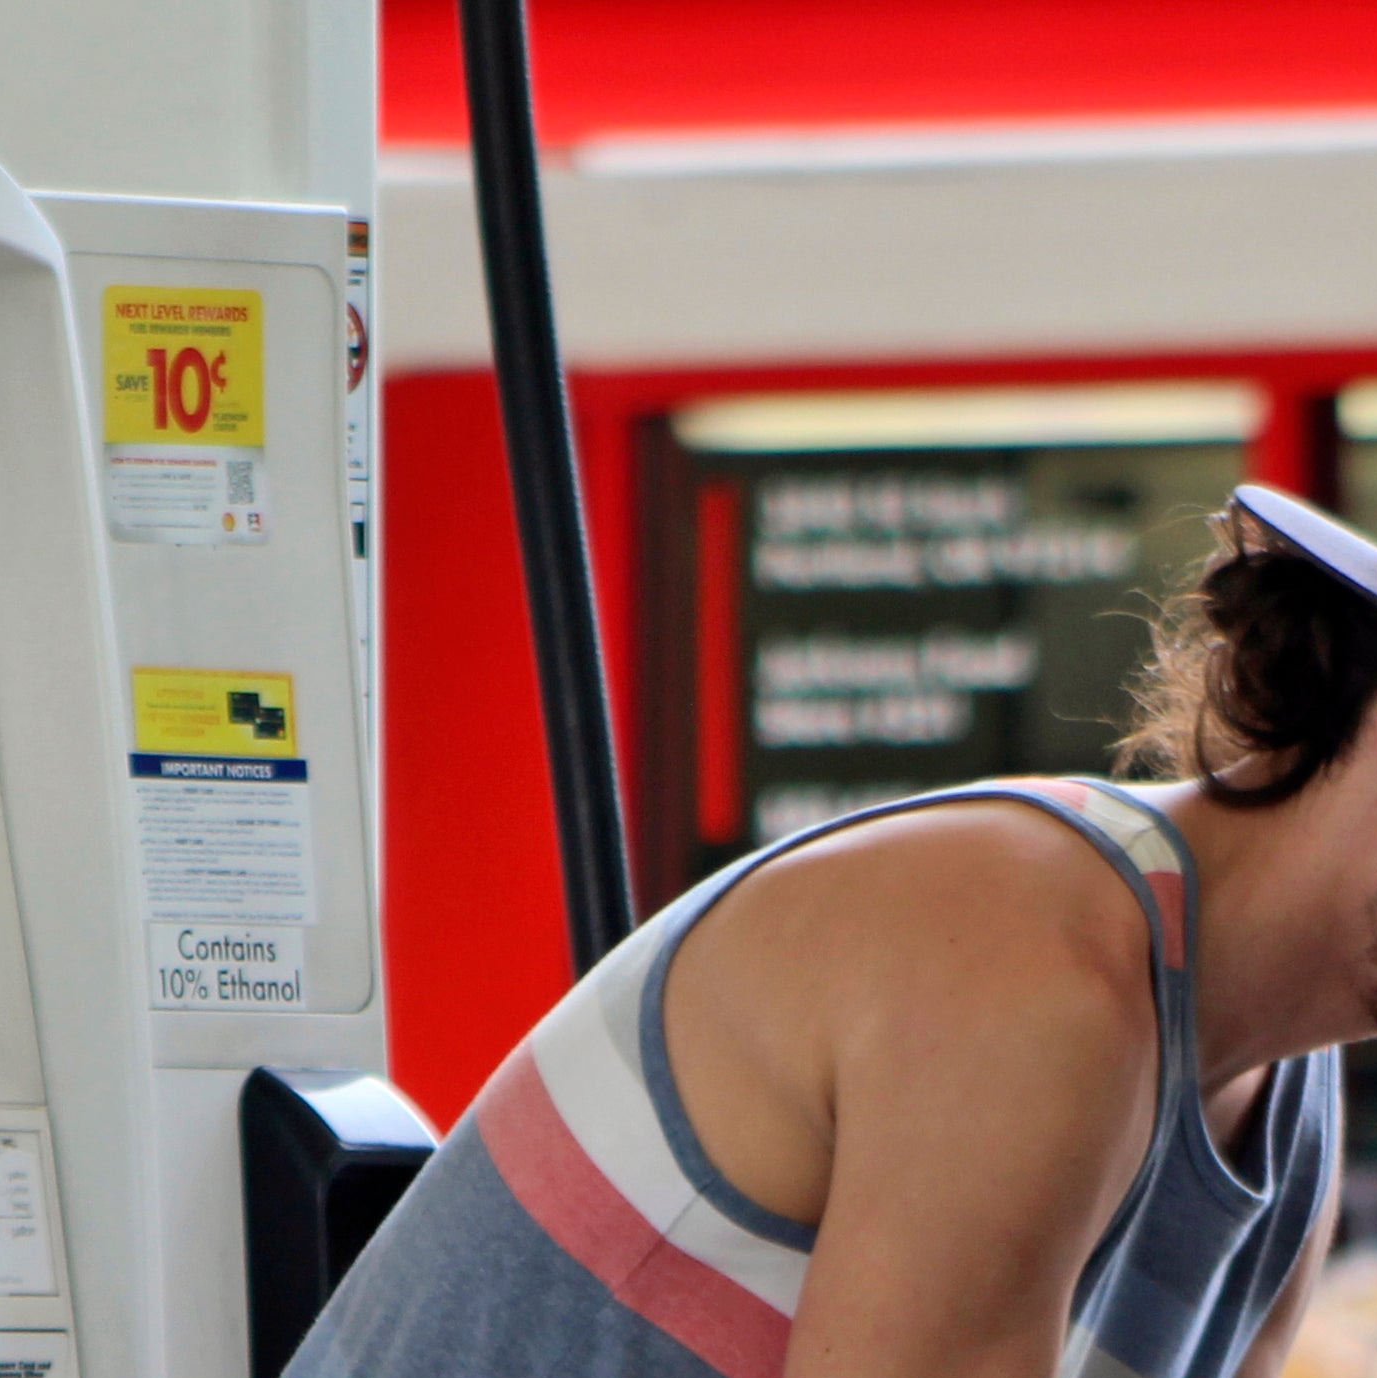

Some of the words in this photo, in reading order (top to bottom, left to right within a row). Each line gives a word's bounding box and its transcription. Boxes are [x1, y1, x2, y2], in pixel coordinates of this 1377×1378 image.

[116, 303, 147, 319] NEXT
[151, 303, 184, 320] LEVEL
[188, 305, 248, 322] REWARDS
[116, 375, 150, 392] SAVE
[146, 346, 228, 433] 10¢
[161, 761, 224, 778] IMPORTANT
[226, 763, 275, 779] NOTICES
[177, 929, 277, 963] Contains
[159, 967, 209, 1001] 10%
[217, 968, 302, 1002] Ethanol
